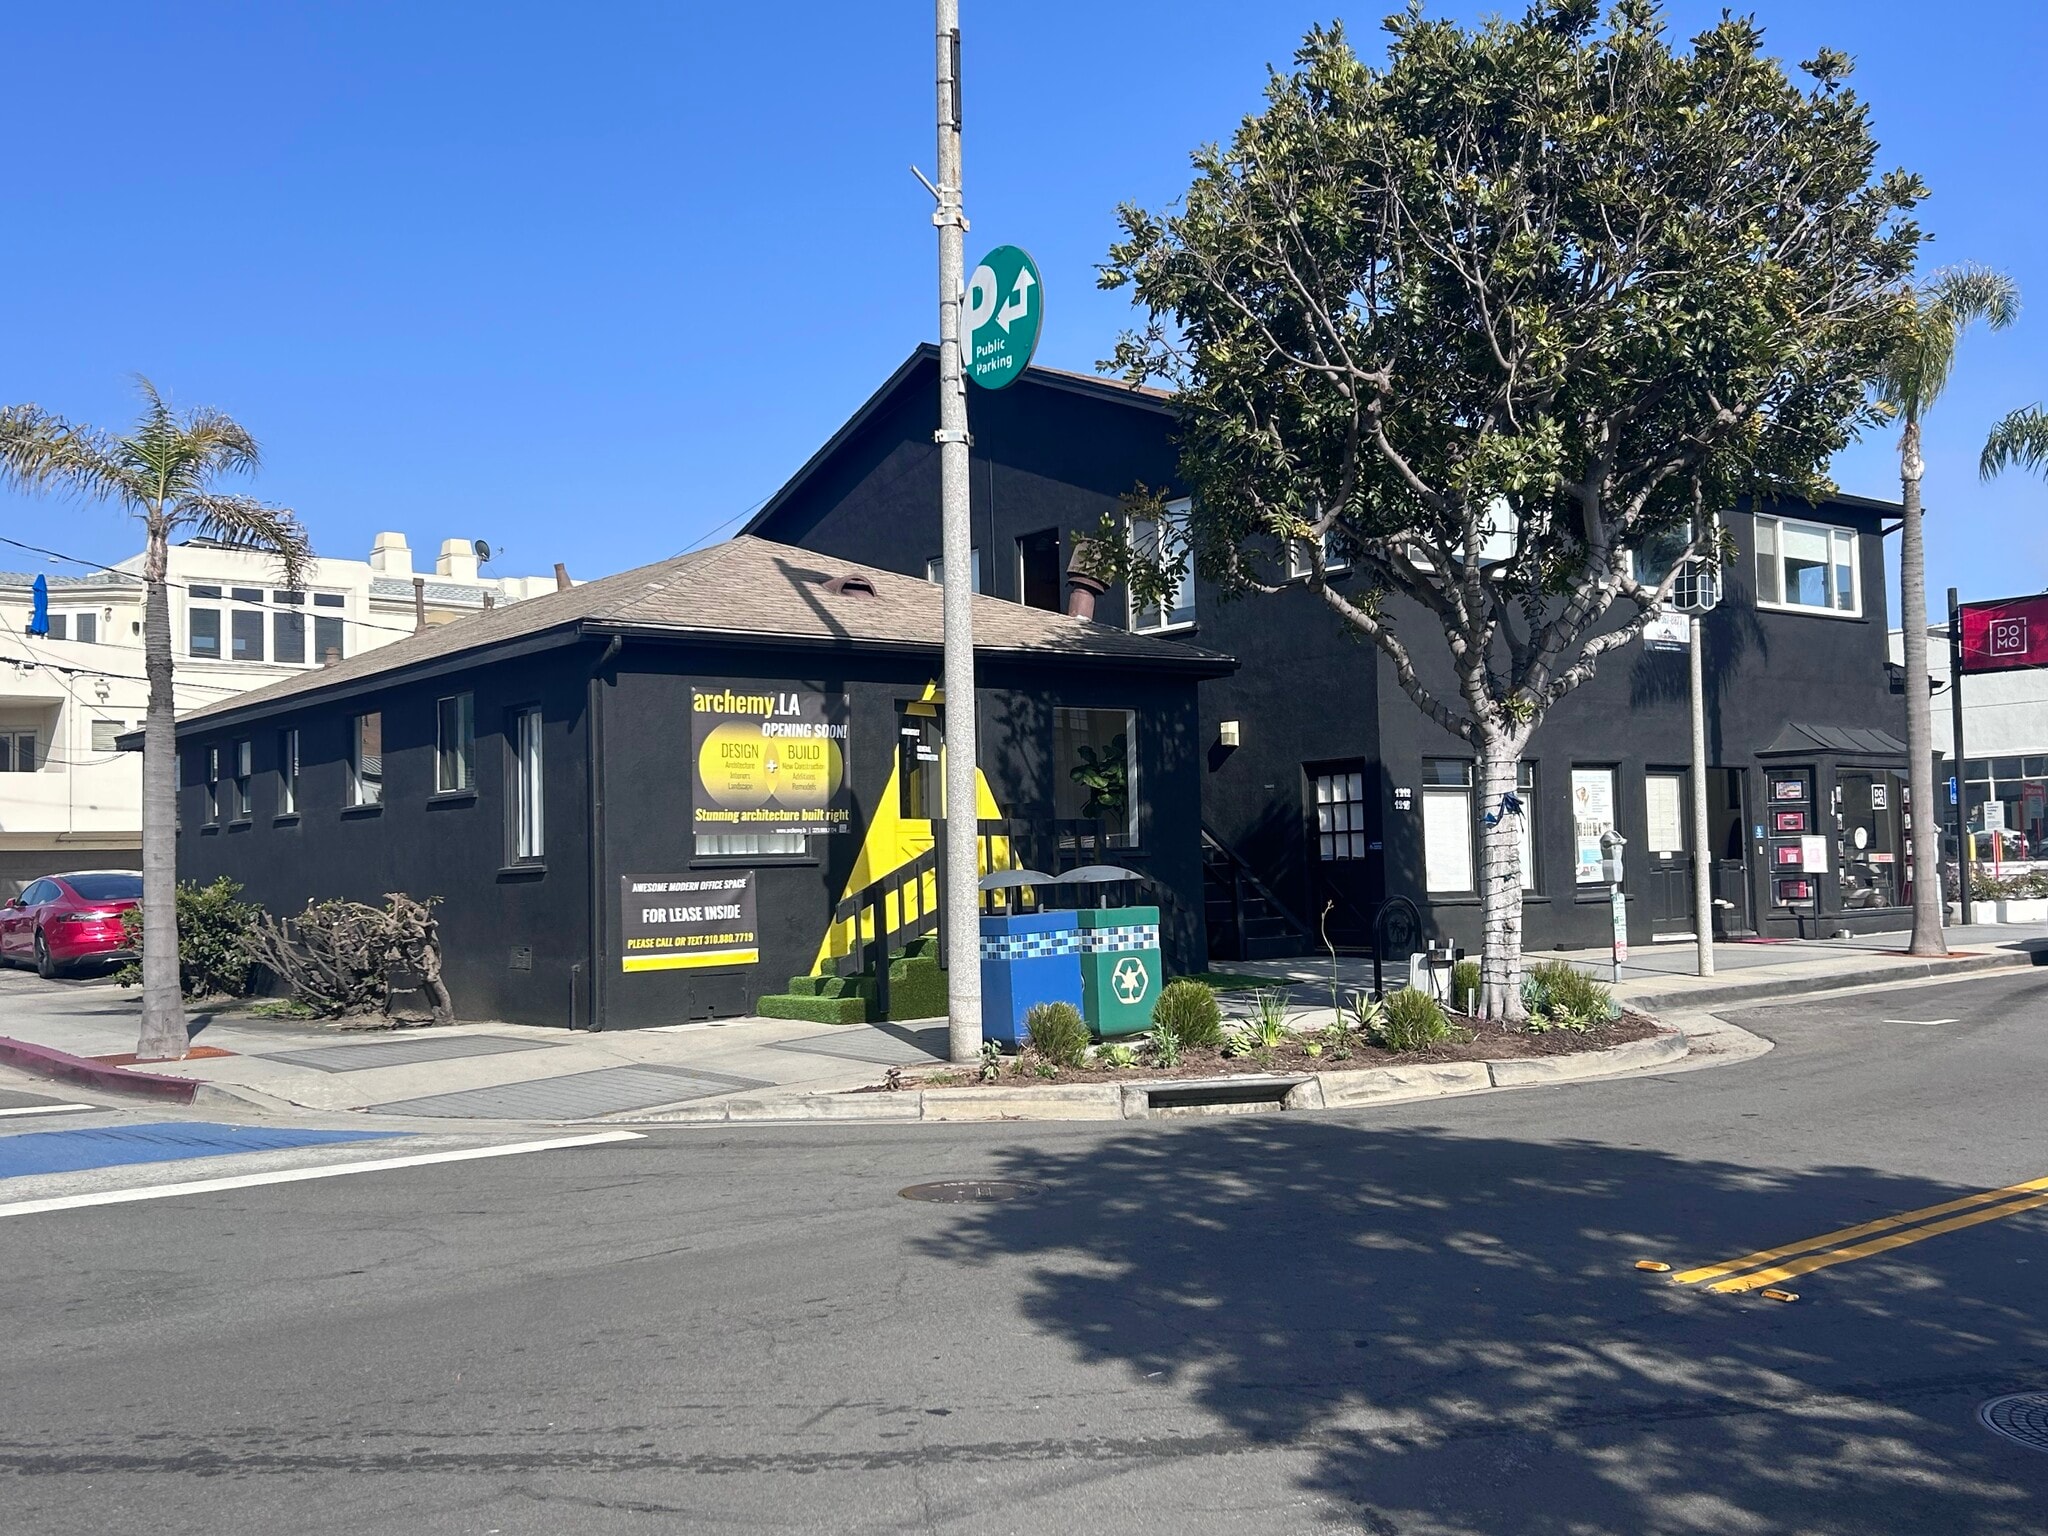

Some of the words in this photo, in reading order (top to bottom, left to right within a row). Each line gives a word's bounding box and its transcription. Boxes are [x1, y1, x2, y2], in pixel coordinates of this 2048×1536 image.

[976, 339, 1005, 358] Public
[976, 355, 1013, 376] Parking
[693, 688, 801, 719] archemy.LA
[762, 722, 812, 738] OPENING
[814, 723, 848, 739] SOON!
[721, 743, 759, 759] DESIGN
[788, 744, 820, 760] BUILD
[725, 761, 756, 769] Architecture
[782, 762, 793, 770] New
[794, 762, 825, 770] Construction
[728, 782, 754, 791] Landscape
[695, 808, 739, 823] Stunning
[741, 808, 800, 821] architecture
[801, 808, 824, 821] built
[825, 809, 850, 822] right
[632, 882, 669, 893] AWESOME
[668, 881, 700, 892] MODERN
[700, 880, 724, 891] OFFICE
[723, 878, 747, 889] SPACE
[642, 908, 667, 923] FOR
[669, 907, 703, 922] LEASE
[704, 904, 741, 920] INSIDE
[627, 938, 655, 949] PLEASE
[655, 937, 674, 948] CALL
[674, 936, 687, 946] OR
[687, 935, 704, 946] TEXT
